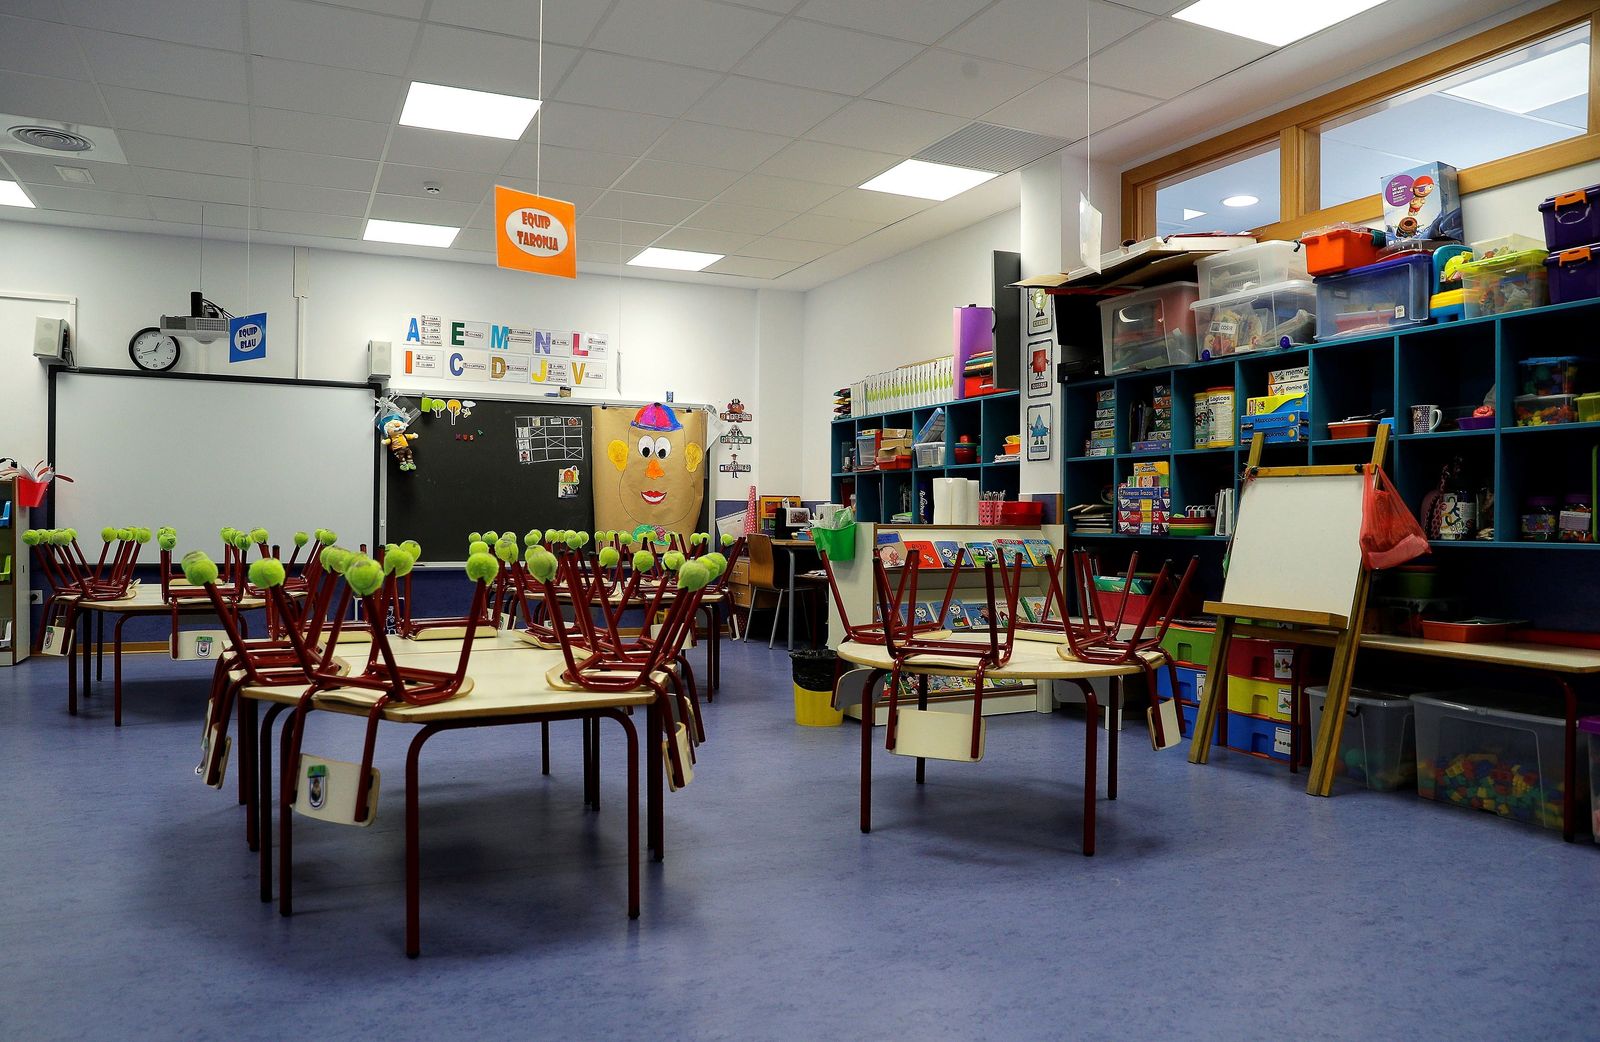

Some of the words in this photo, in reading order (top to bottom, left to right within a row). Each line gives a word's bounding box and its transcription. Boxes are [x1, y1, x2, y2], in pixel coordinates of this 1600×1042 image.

[521, 211, 551, 230] EQUIP
[516, 230, 559, 252] TARONJA
[238, 326, 258, 338] EQUIP
[406, 318, 420, 342] A
[451, 322, 465, 346] E
[491, 325, 509, 349] M
[240, 338, 257, 349] BLAU
[534, 331, 551, 354] N
[572, 333, 588, 356] L
[449, 352, 464, 377] C
[491, 357, 507, 379] D
[532, 359, 548, 382] J
[571, 361, 586, 385] V
[1285, 368, 1304, 377] memo
[1285, 384, 1303, 392] domino
